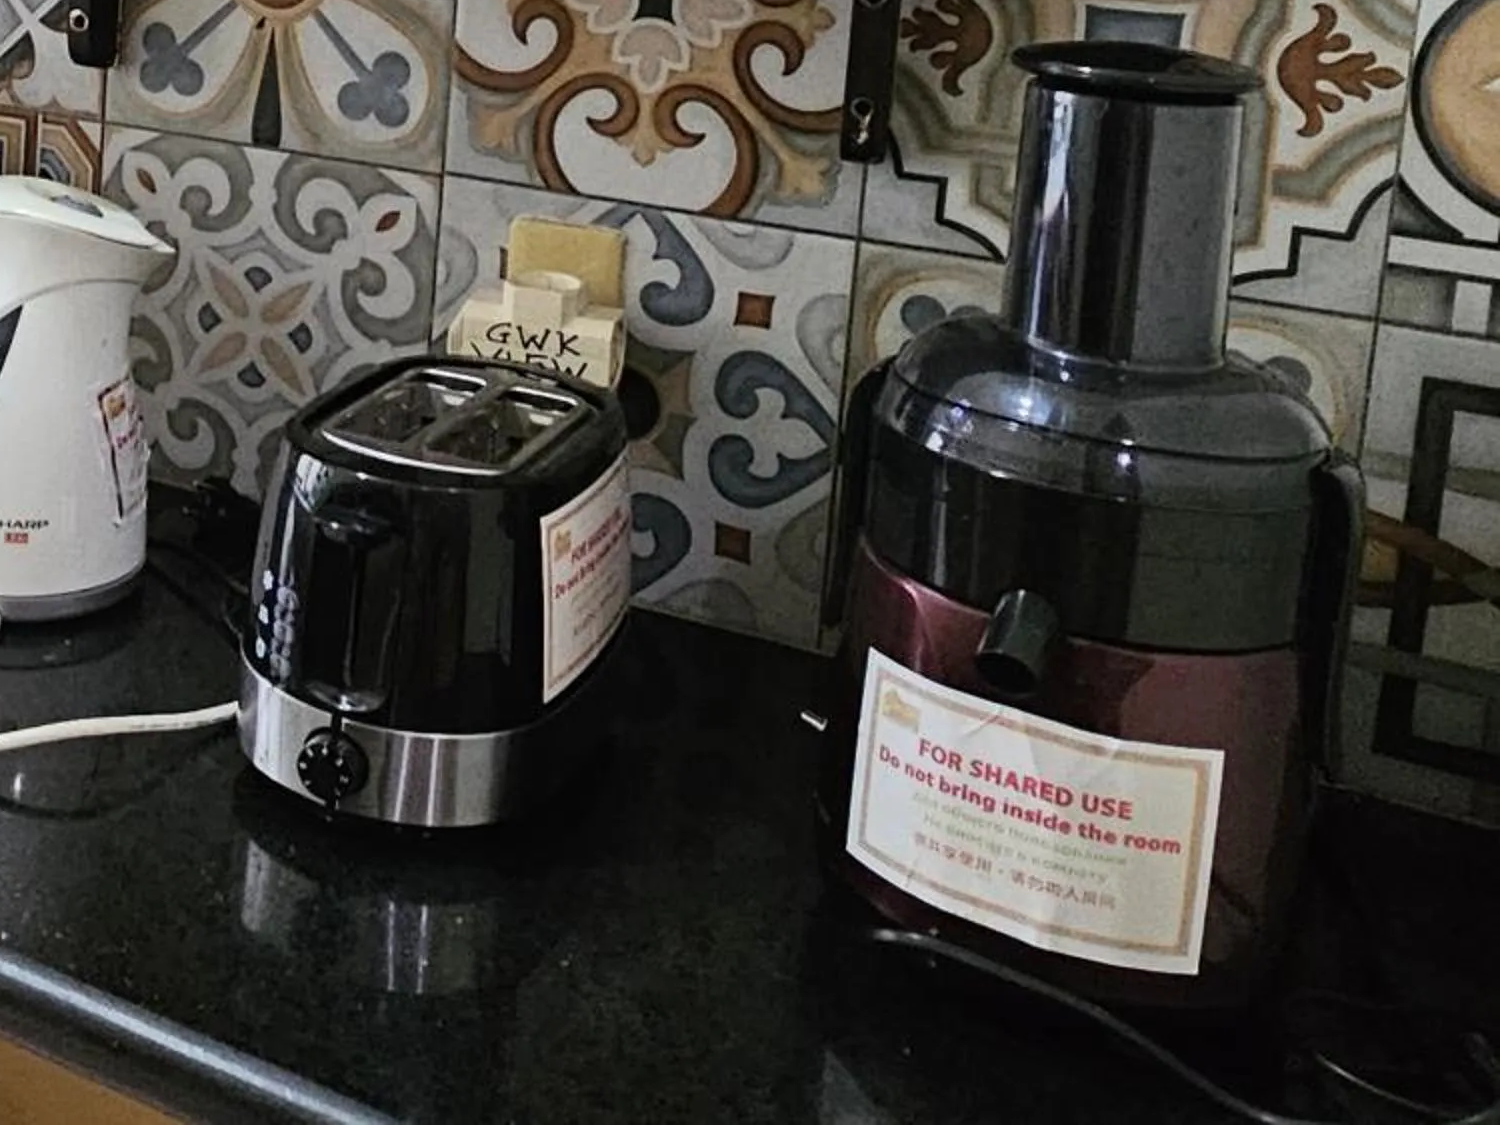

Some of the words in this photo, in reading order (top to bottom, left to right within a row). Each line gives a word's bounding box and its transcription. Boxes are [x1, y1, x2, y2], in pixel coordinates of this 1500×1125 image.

[486, 322, 581, 356] GWK
[879, 744, 901, 771] Do
[904, 761, 934, 789] not
[938, 775, 997, 814] bring
[1002, 800, 1071, 836] inside
[1078, 821, 1117, 845] the
[1123, 833, 1181, 855] room
[919, 738, 963, 772] FOR
[968, 758, 1074, 808] SHARED
[1081, 792, 1133, 821] USE
